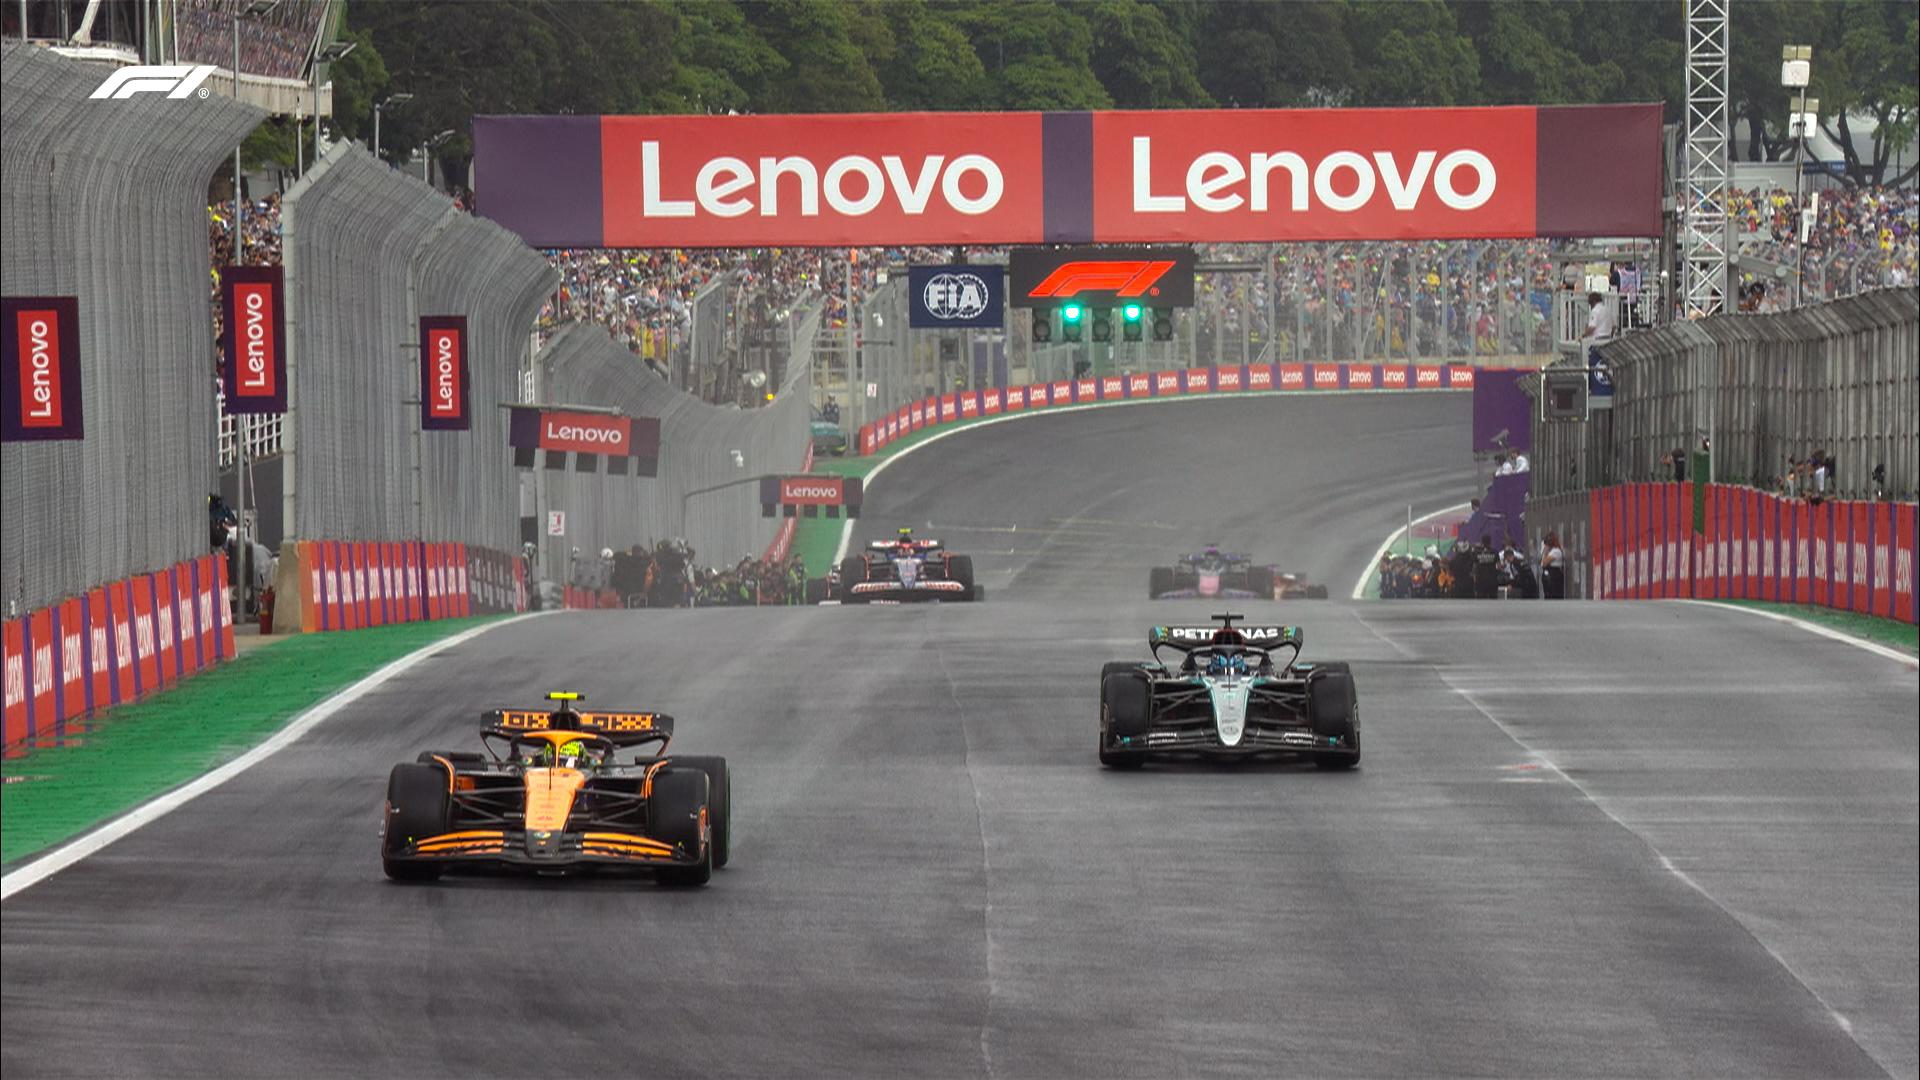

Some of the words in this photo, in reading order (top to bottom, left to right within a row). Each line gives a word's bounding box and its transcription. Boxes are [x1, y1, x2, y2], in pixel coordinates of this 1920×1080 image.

[642, 140, 1004, 218] Lenovo
[1133, 136, 1497, 213] Lenovo
[244, 293, 265, 388] Lenovo
[30, 320, 52, 418] Lenovo
[436, 336, 453, 411] Lenovo
[1314, 369, 1337, 383] Lenovo
[1383, 369, 1405, 383] Lenovo
[1417, 368, 1439, 383] Lenovo
[1450, 369, 1472, 383] Lenovo
[1158, 375, 1177, 390] Lenovo
[1187, 373, 1207, 387] Lenovo
[1218, 371, 1238, 385] Lenovo
[1249, 370, 1270, 384] Lenovo
[1281, 370, 1302, 384] Lenovo
[1349, 370, 1371, 384] Lenovo
[547, 422, 622, 444] Lenovo
[785, 484, 837, 498] Lenovo
